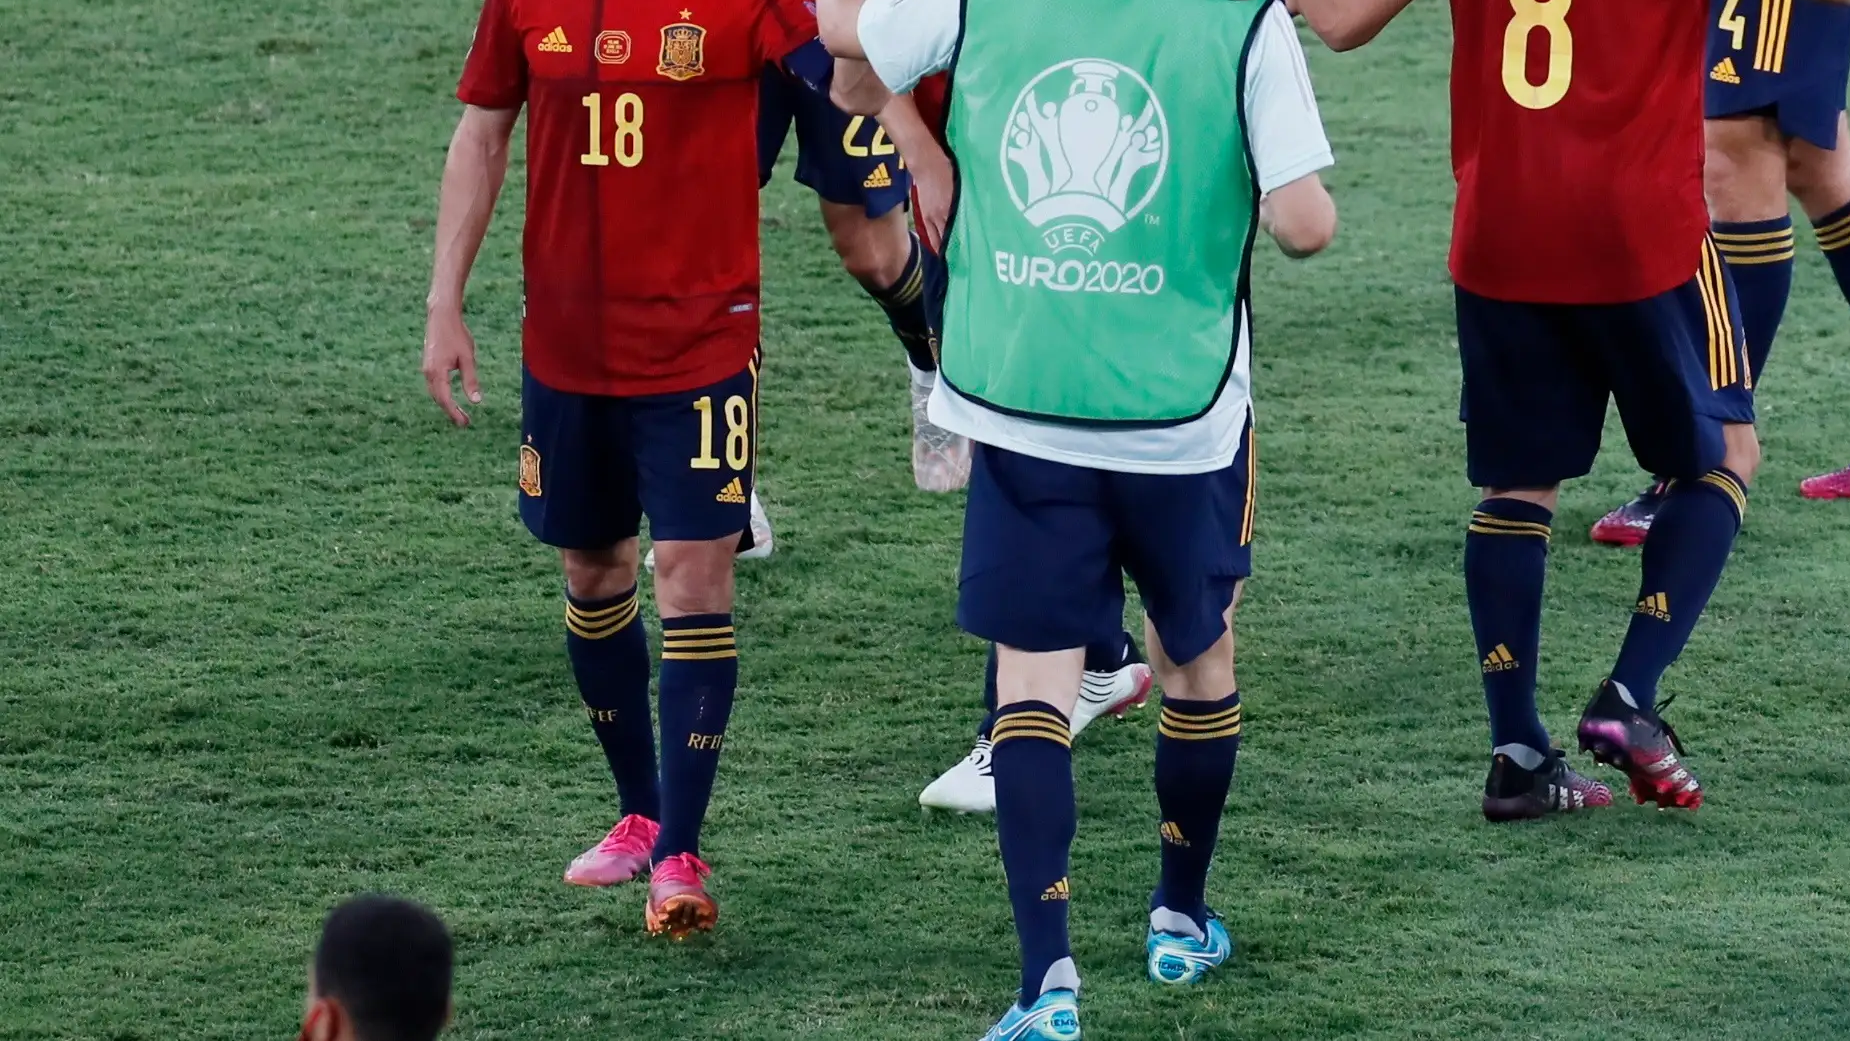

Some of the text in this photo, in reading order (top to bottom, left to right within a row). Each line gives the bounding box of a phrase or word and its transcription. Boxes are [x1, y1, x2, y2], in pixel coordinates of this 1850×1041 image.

[537, 42, 573, 53] adidas
[1709, 71, 1741, 84] adidas
[580, 92, 644, 167] 18
[1044, 228, 1102, 254] UEFA
[690, 395, 749, 471] 18
[716, 492, 746, 504] adidas
